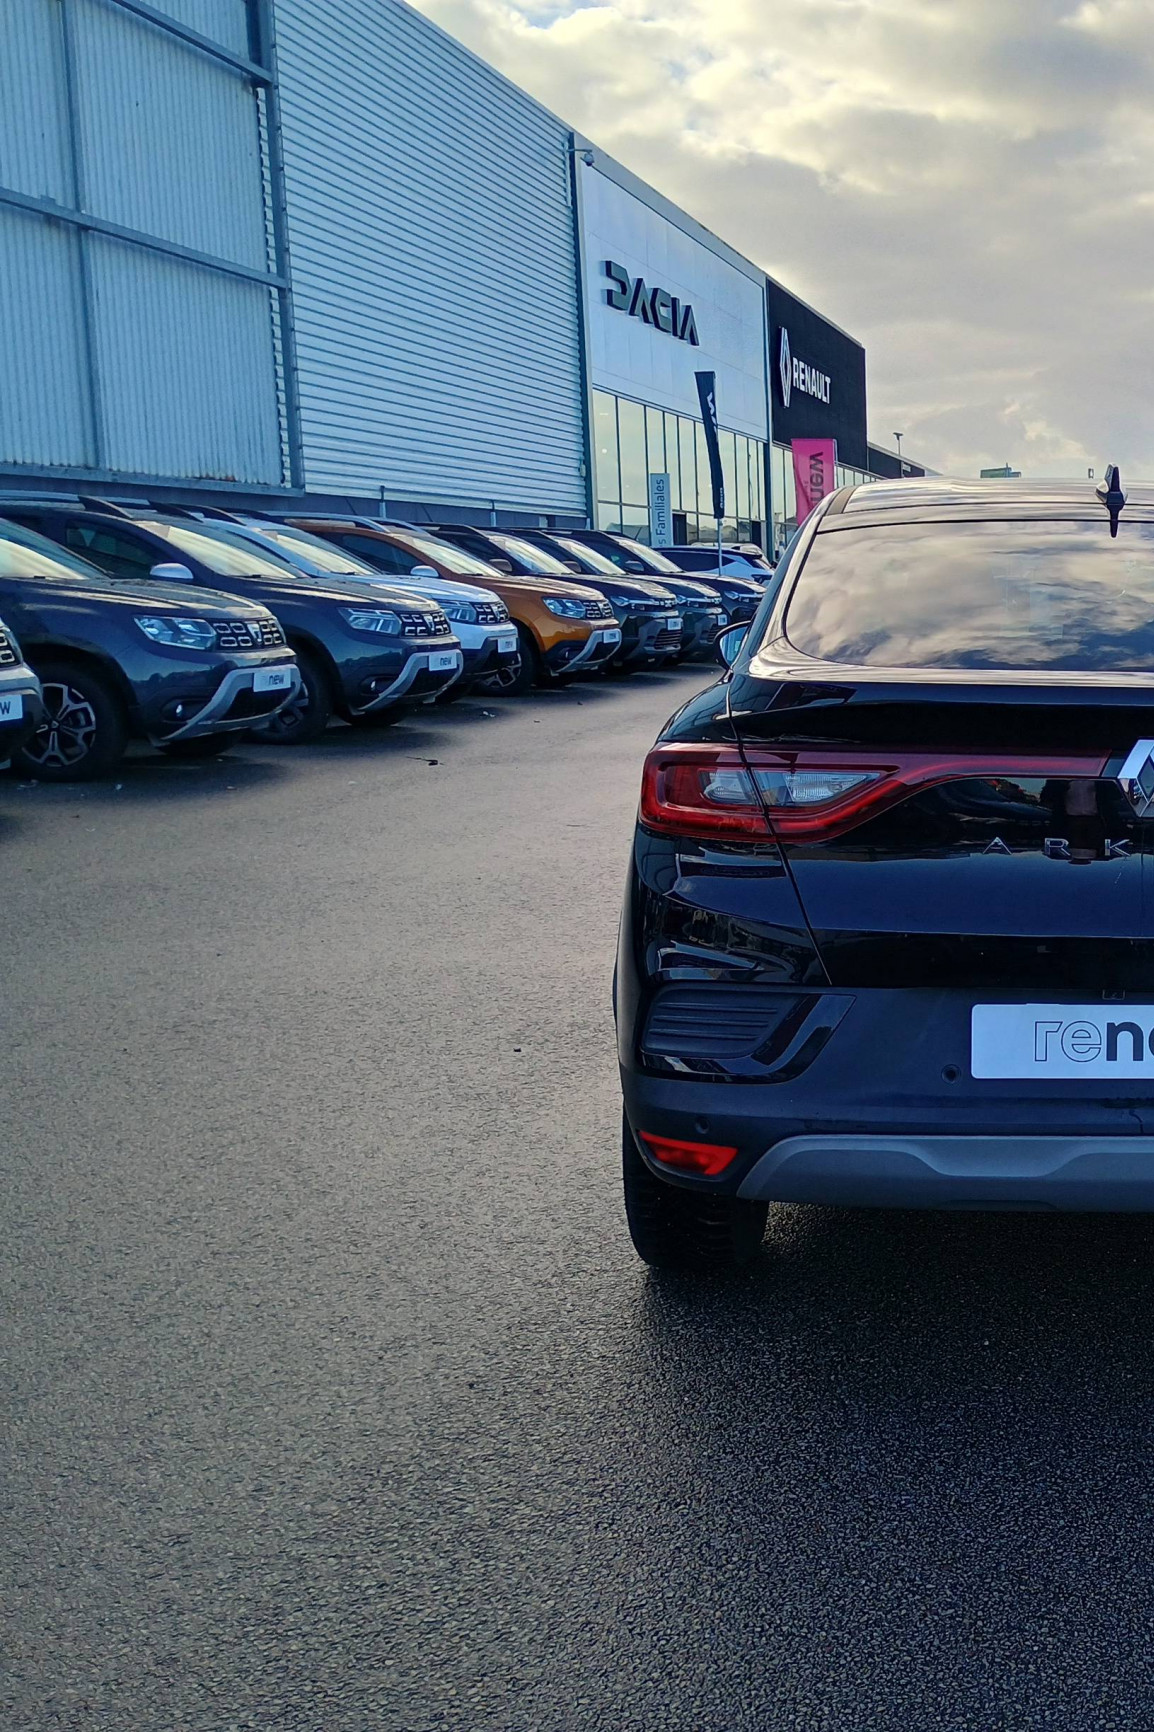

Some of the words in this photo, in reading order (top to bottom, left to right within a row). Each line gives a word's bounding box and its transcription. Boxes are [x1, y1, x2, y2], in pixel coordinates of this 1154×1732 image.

[605, 260, 699, 346] DACIA
[793, 357, 831, 404] RENAULT
[654, 478, 666, 536] Familiales
